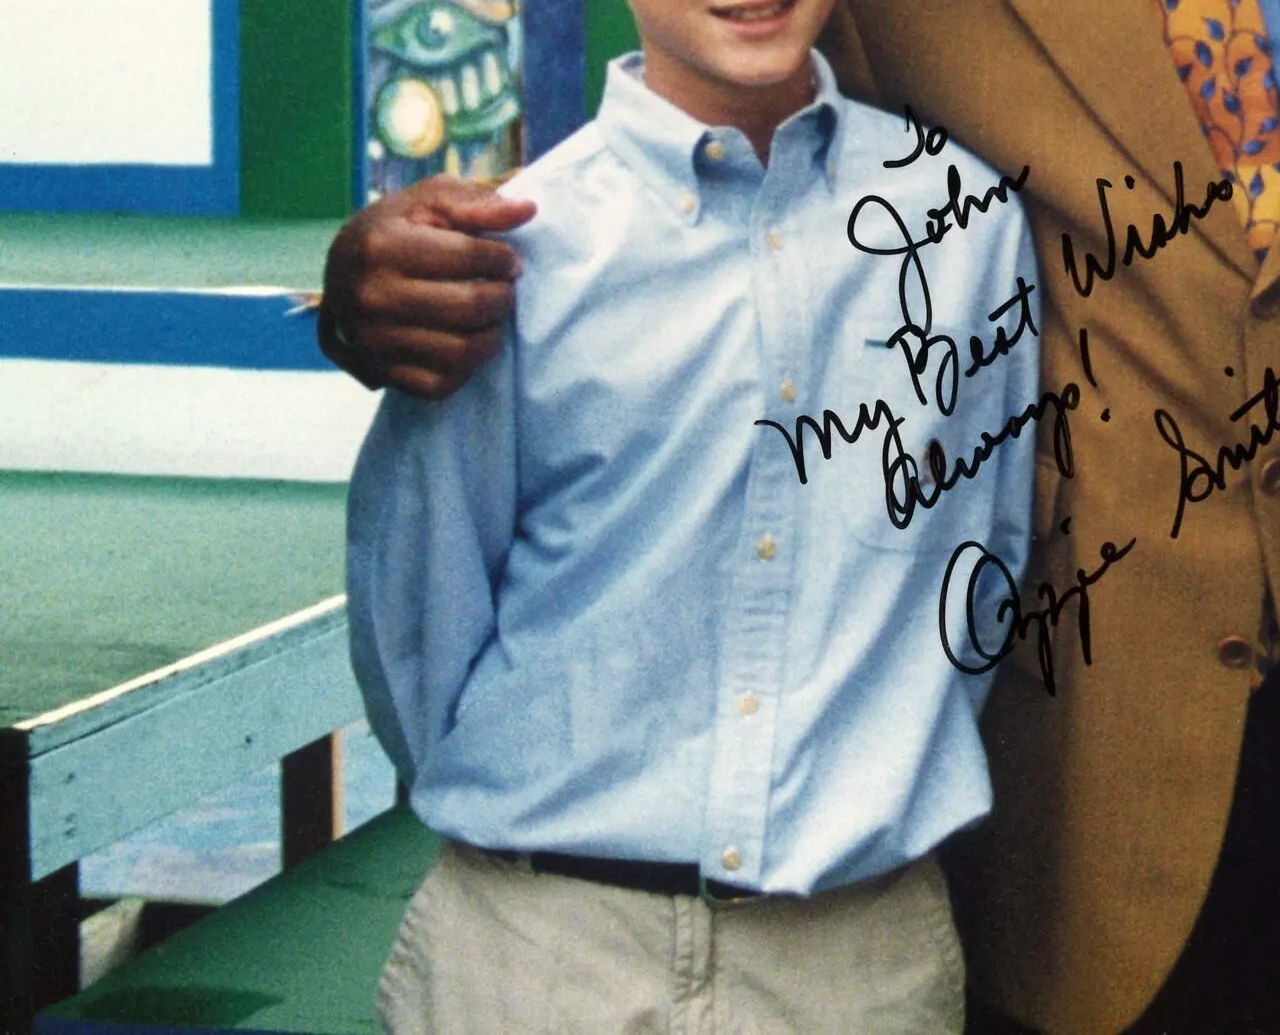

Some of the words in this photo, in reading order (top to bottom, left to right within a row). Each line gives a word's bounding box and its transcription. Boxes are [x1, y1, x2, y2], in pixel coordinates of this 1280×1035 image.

[884, 105, 948, 168] To
[847, 164, 1030, 335] John
[754, 399, 905, 527] My
[886, 276, 1039, 417] Best
[939, 516, 1137, 697] Ozzie
